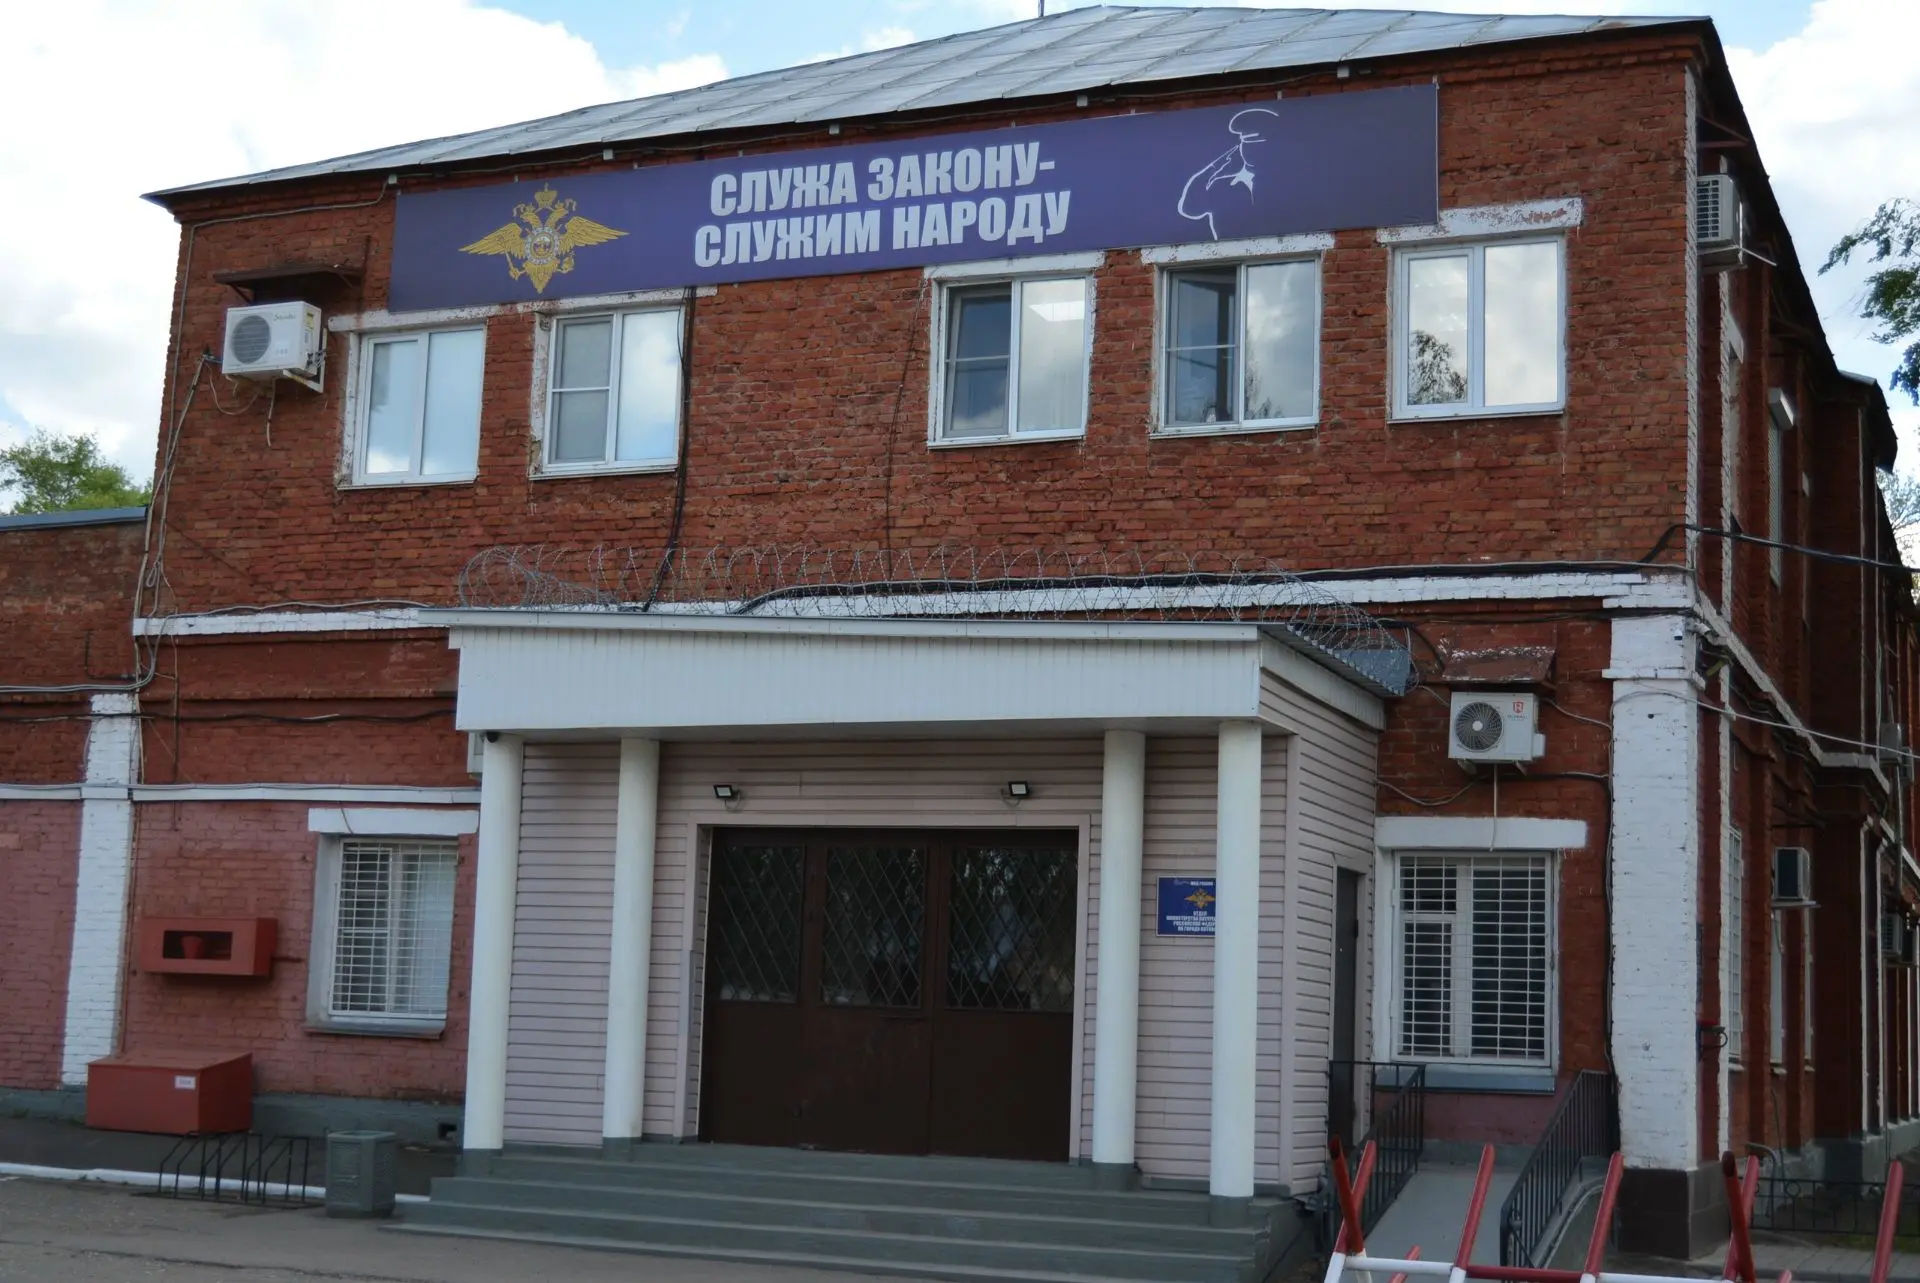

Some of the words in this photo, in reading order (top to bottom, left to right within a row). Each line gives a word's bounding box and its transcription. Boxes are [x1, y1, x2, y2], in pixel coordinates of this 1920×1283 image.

[710, 161, 858, 217] СЛУЖА
[867, 141, 1056, 201] ЗАКОНУ-
[694, 209, 881, 268] СЛУЖИМ
[892, 190, 1072, 250] НАРОДУ
